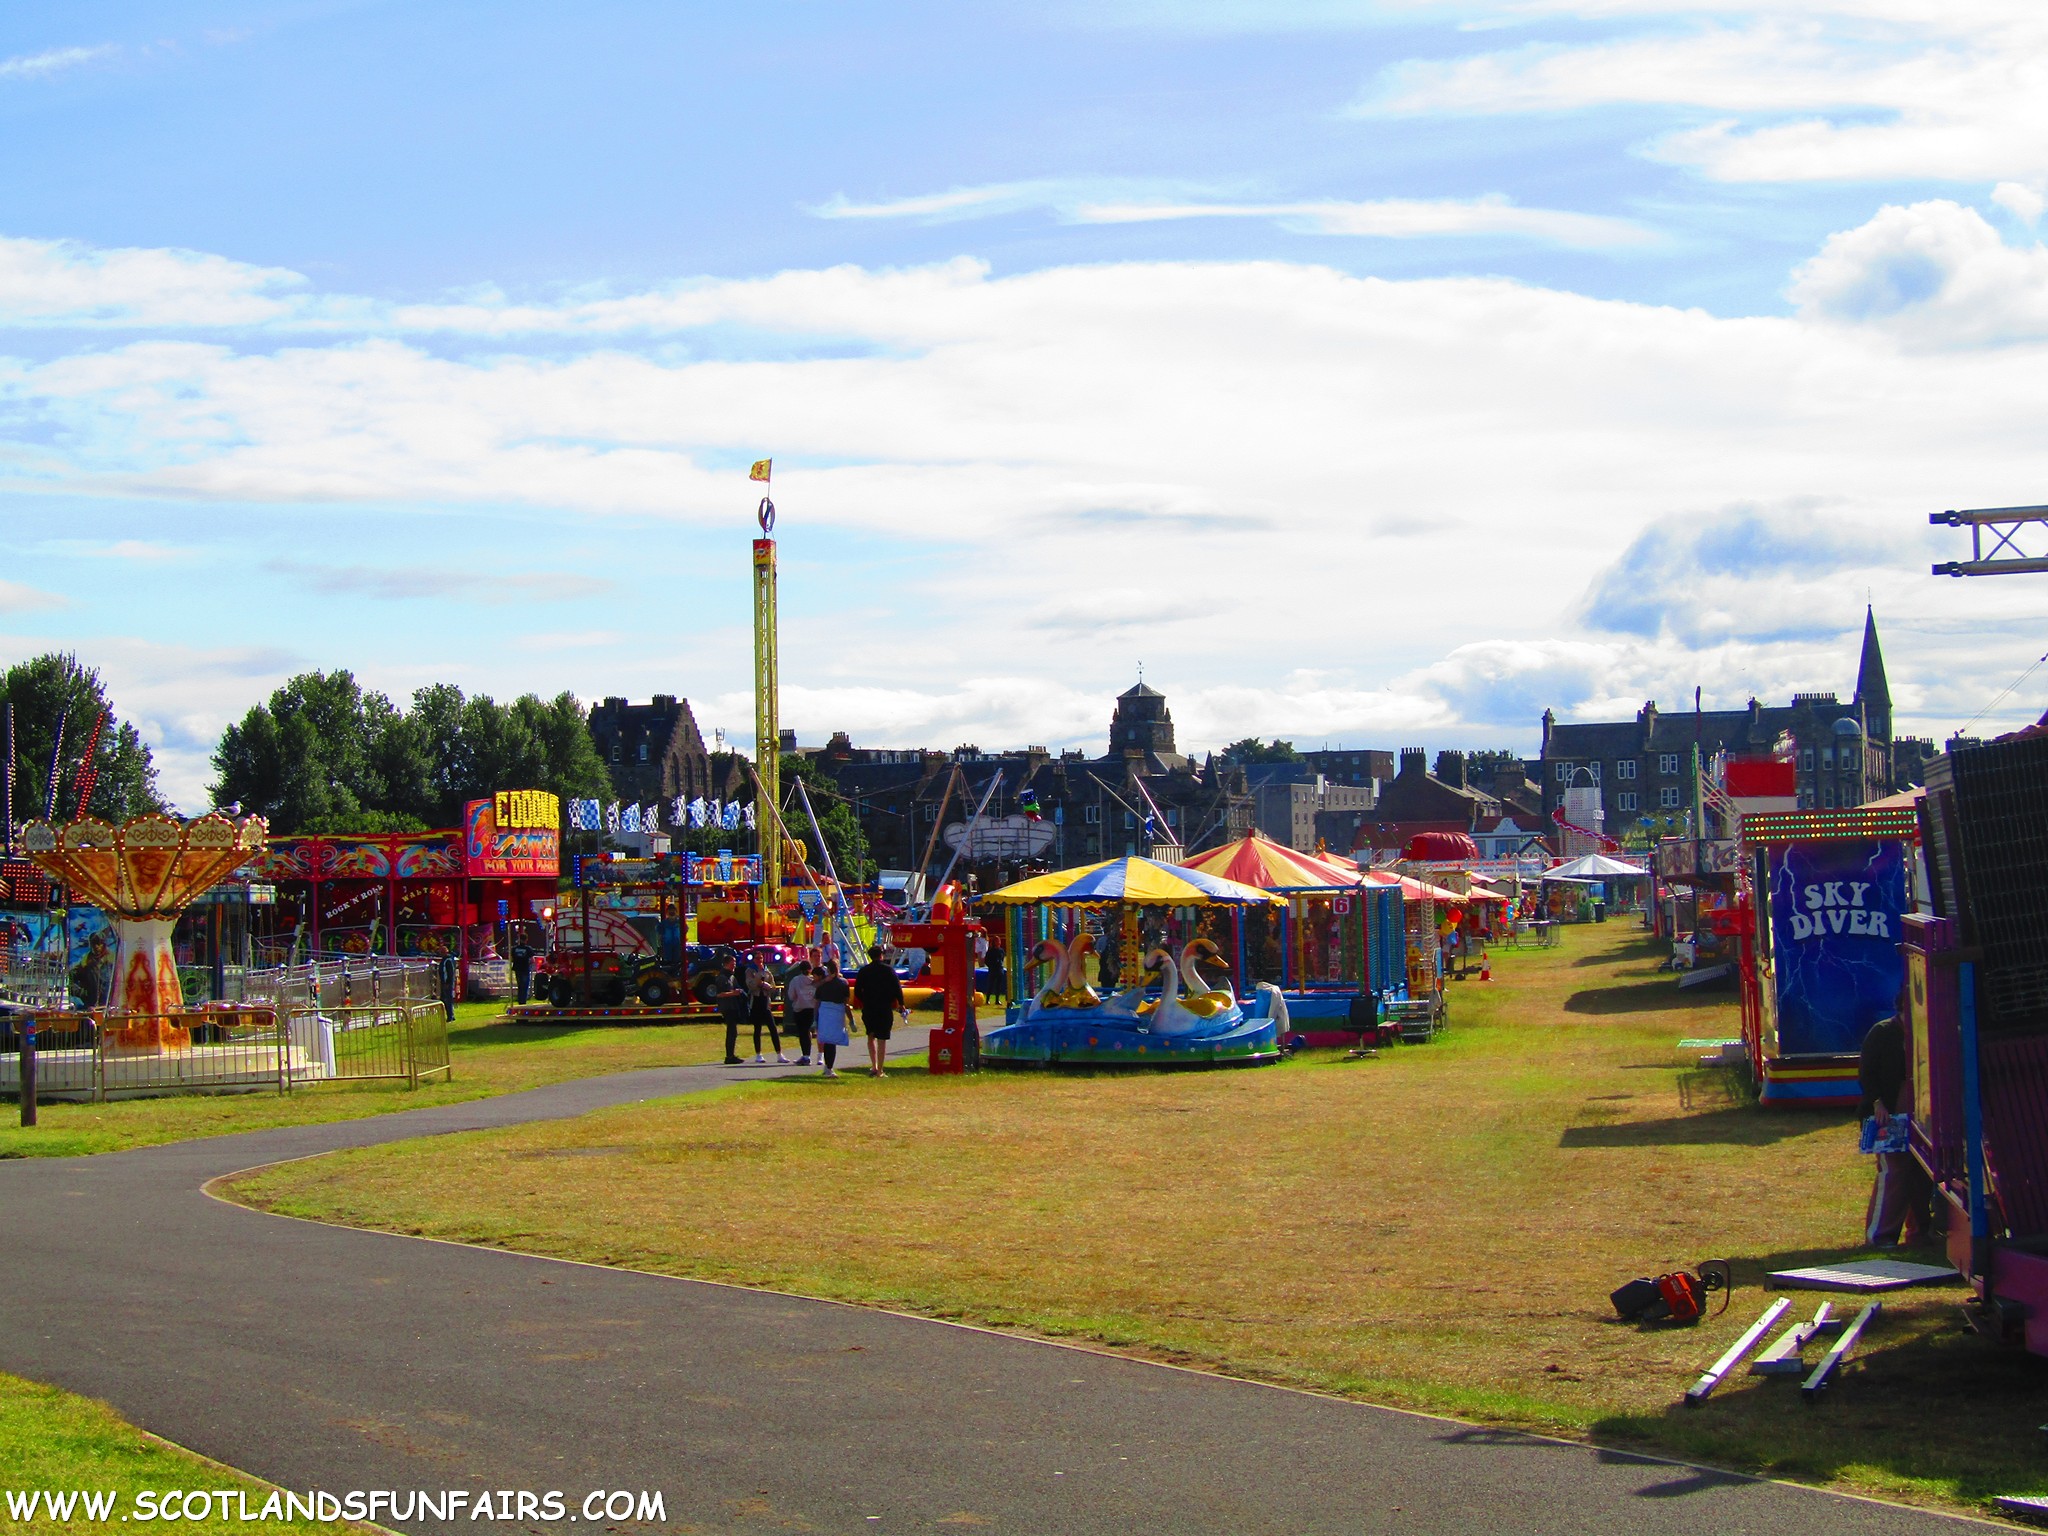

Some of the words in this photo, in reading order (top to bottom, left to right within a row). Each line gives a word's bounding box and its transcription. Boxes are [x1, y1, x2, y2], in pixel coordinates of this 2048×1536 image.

[483, 859, 507, 873] FOR
[511, 859, 534, 873] YOUR
[325, 901, 351, 919] ROCK
[360, 884, 384, 900] ROLL
[401, 887, 450, 902] WALTZER
[1804, 881, 1870, 909] SKY
[1335, 899, 1348, 913] 6
[1789, 909, 1890, 940] DIVER
